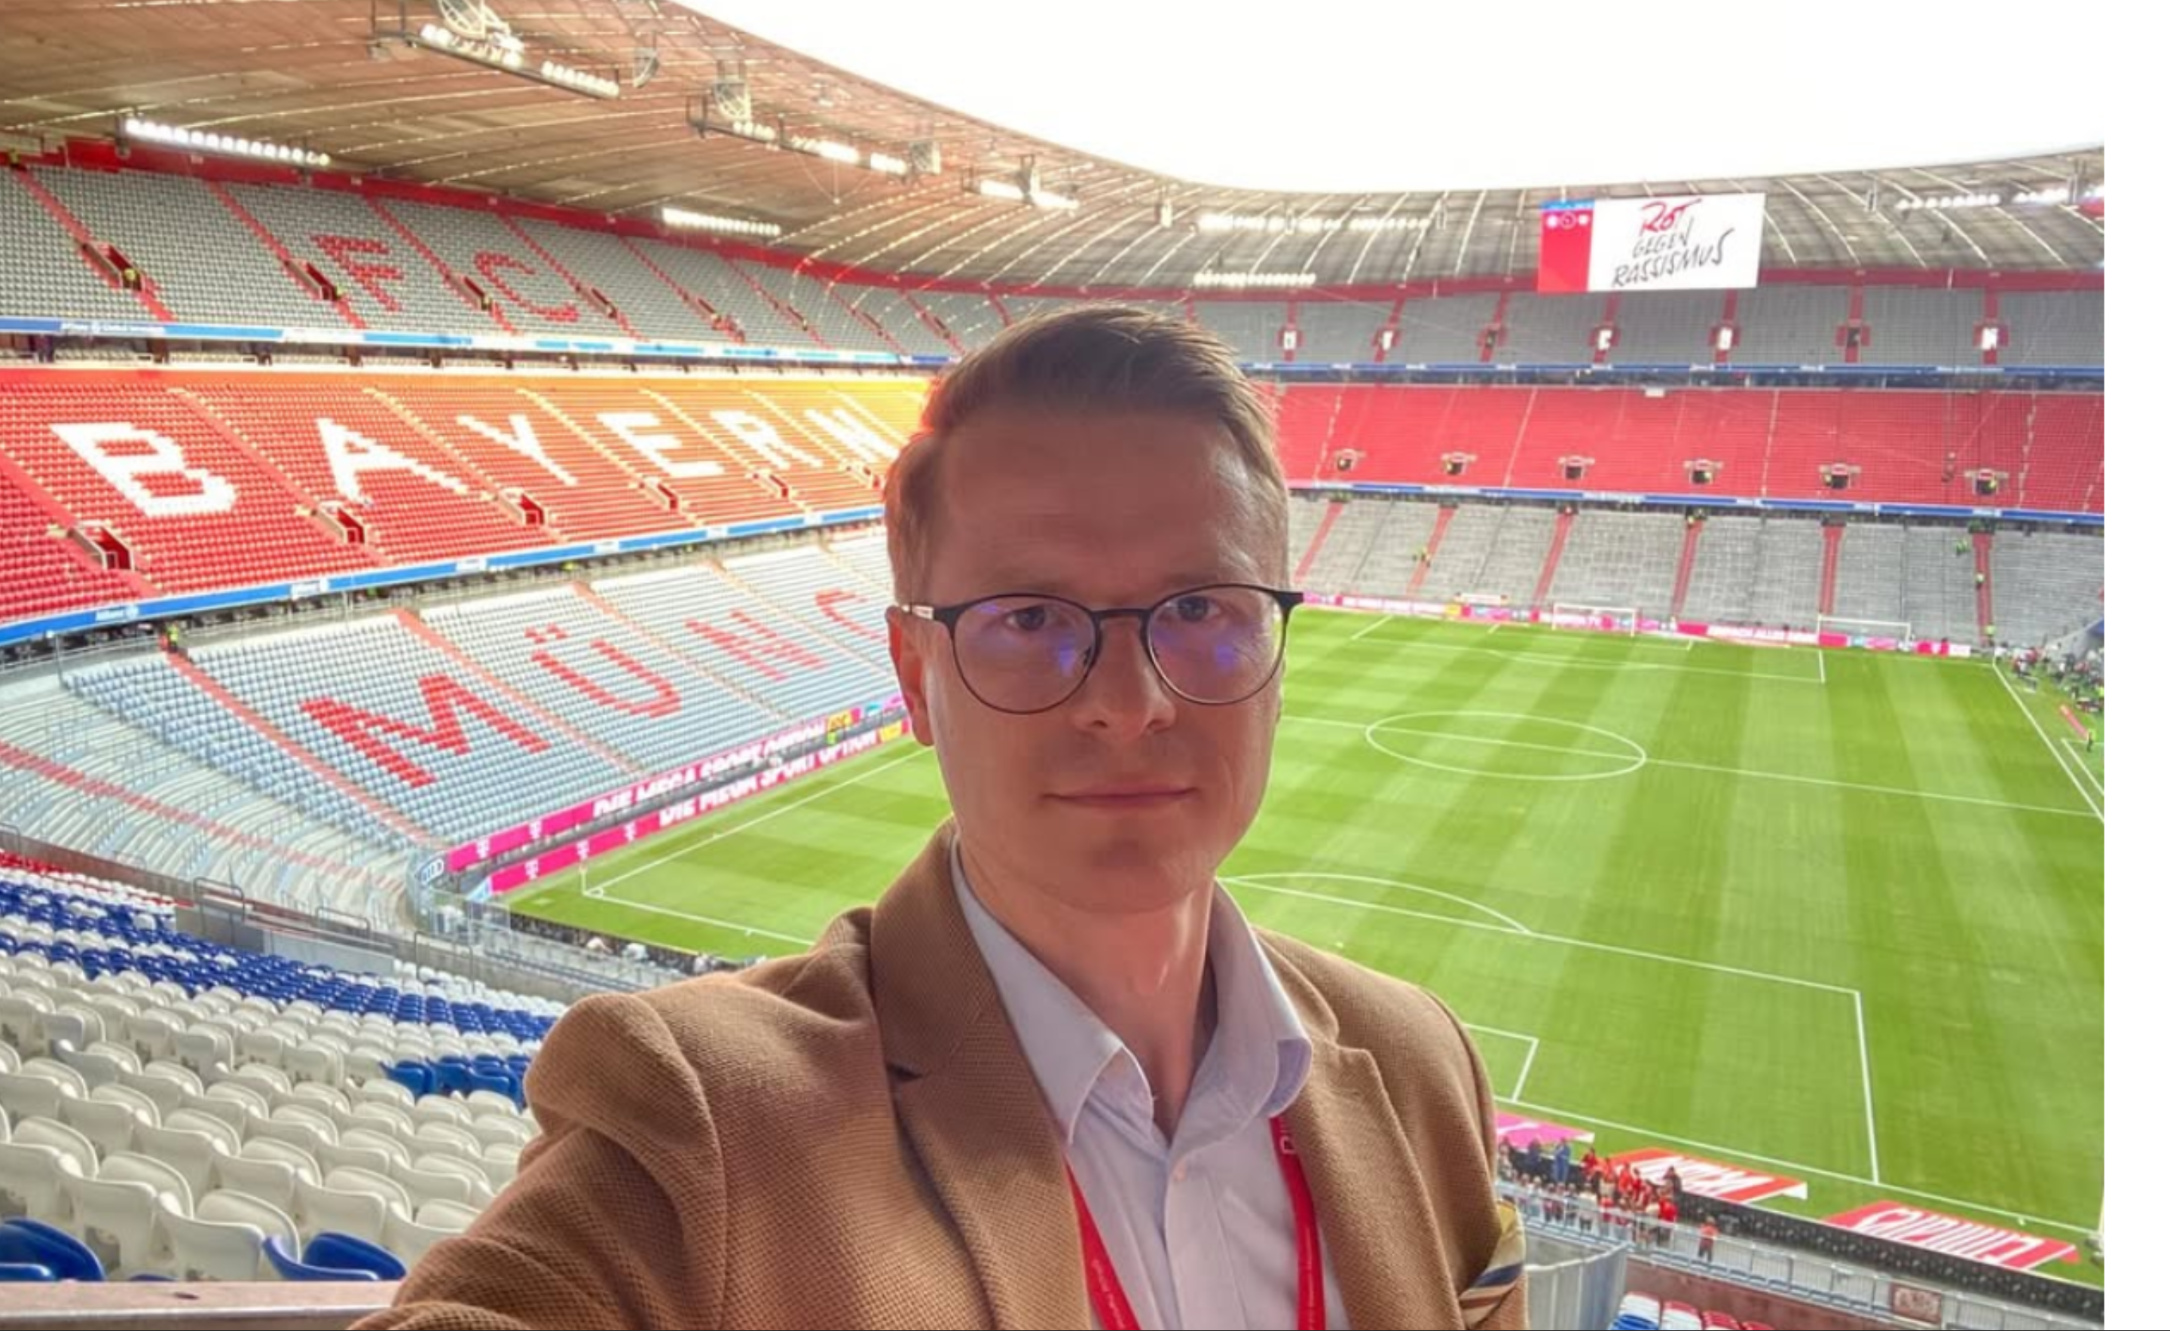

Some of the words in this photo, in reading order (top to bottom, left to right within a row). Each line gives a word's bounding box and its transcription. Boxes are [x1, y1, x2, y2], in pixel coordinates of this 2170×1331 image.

[1632, 216, 1695, 258] GEGEN
[1640, 199, 1702, 236] ROT
[309, 233, 582, 323] FC
[1611, 227, 1735, 287] RASSISMUS
[48, 408, 901, 517] BAYERN
